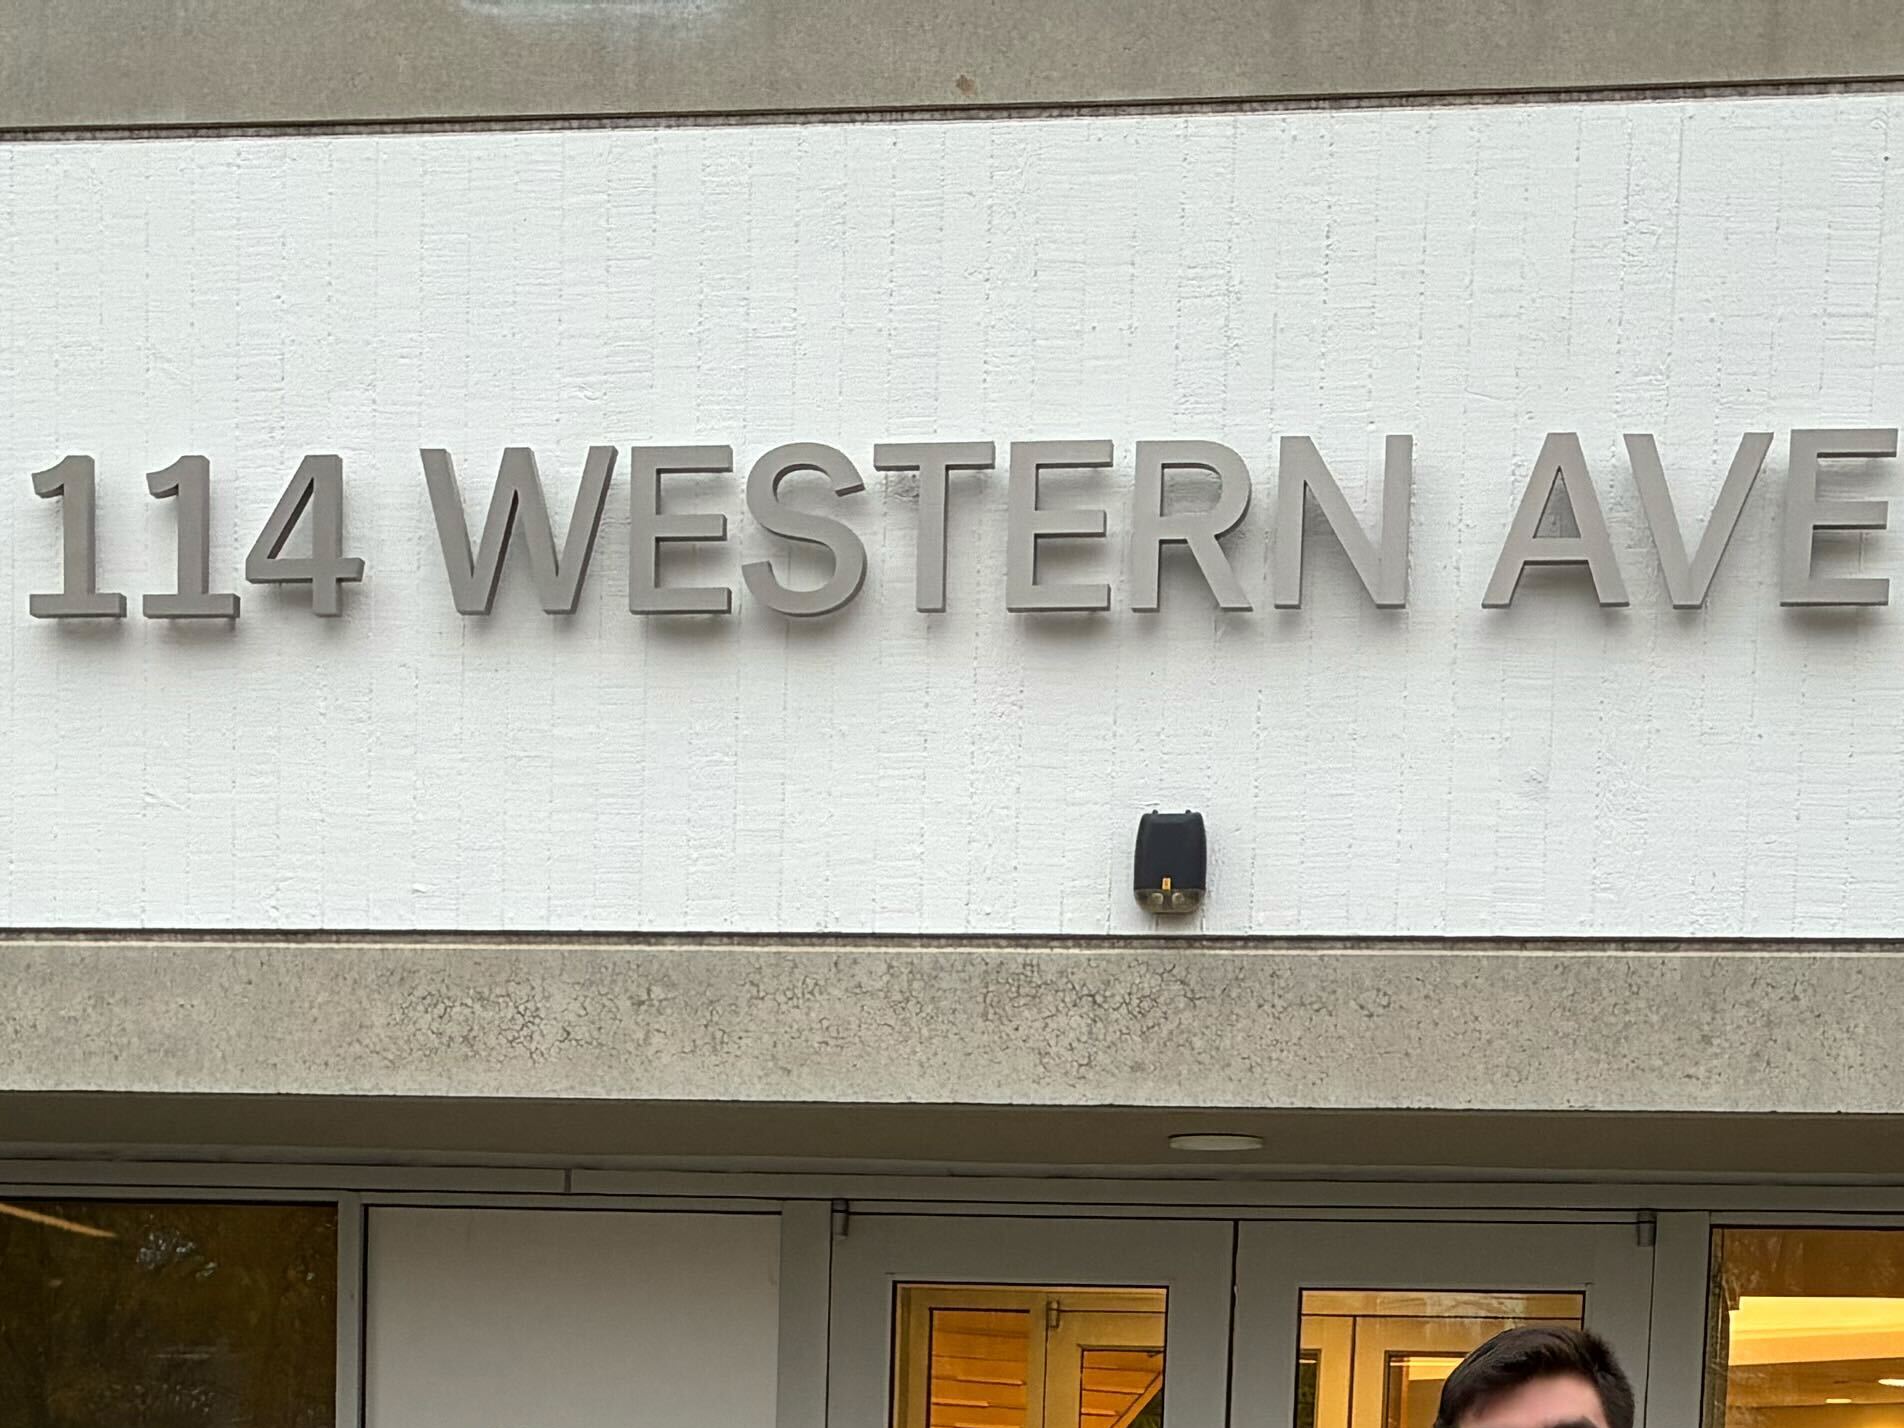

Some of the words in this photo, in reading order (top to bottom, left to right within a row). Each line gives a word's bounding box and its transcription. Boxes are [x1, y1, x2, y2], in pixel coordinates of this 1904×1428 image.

[29, 454, 366, 619] 114
[419, 433, 1414, 616] WESTERN
[1481, 427, 1899, 610] AVE
